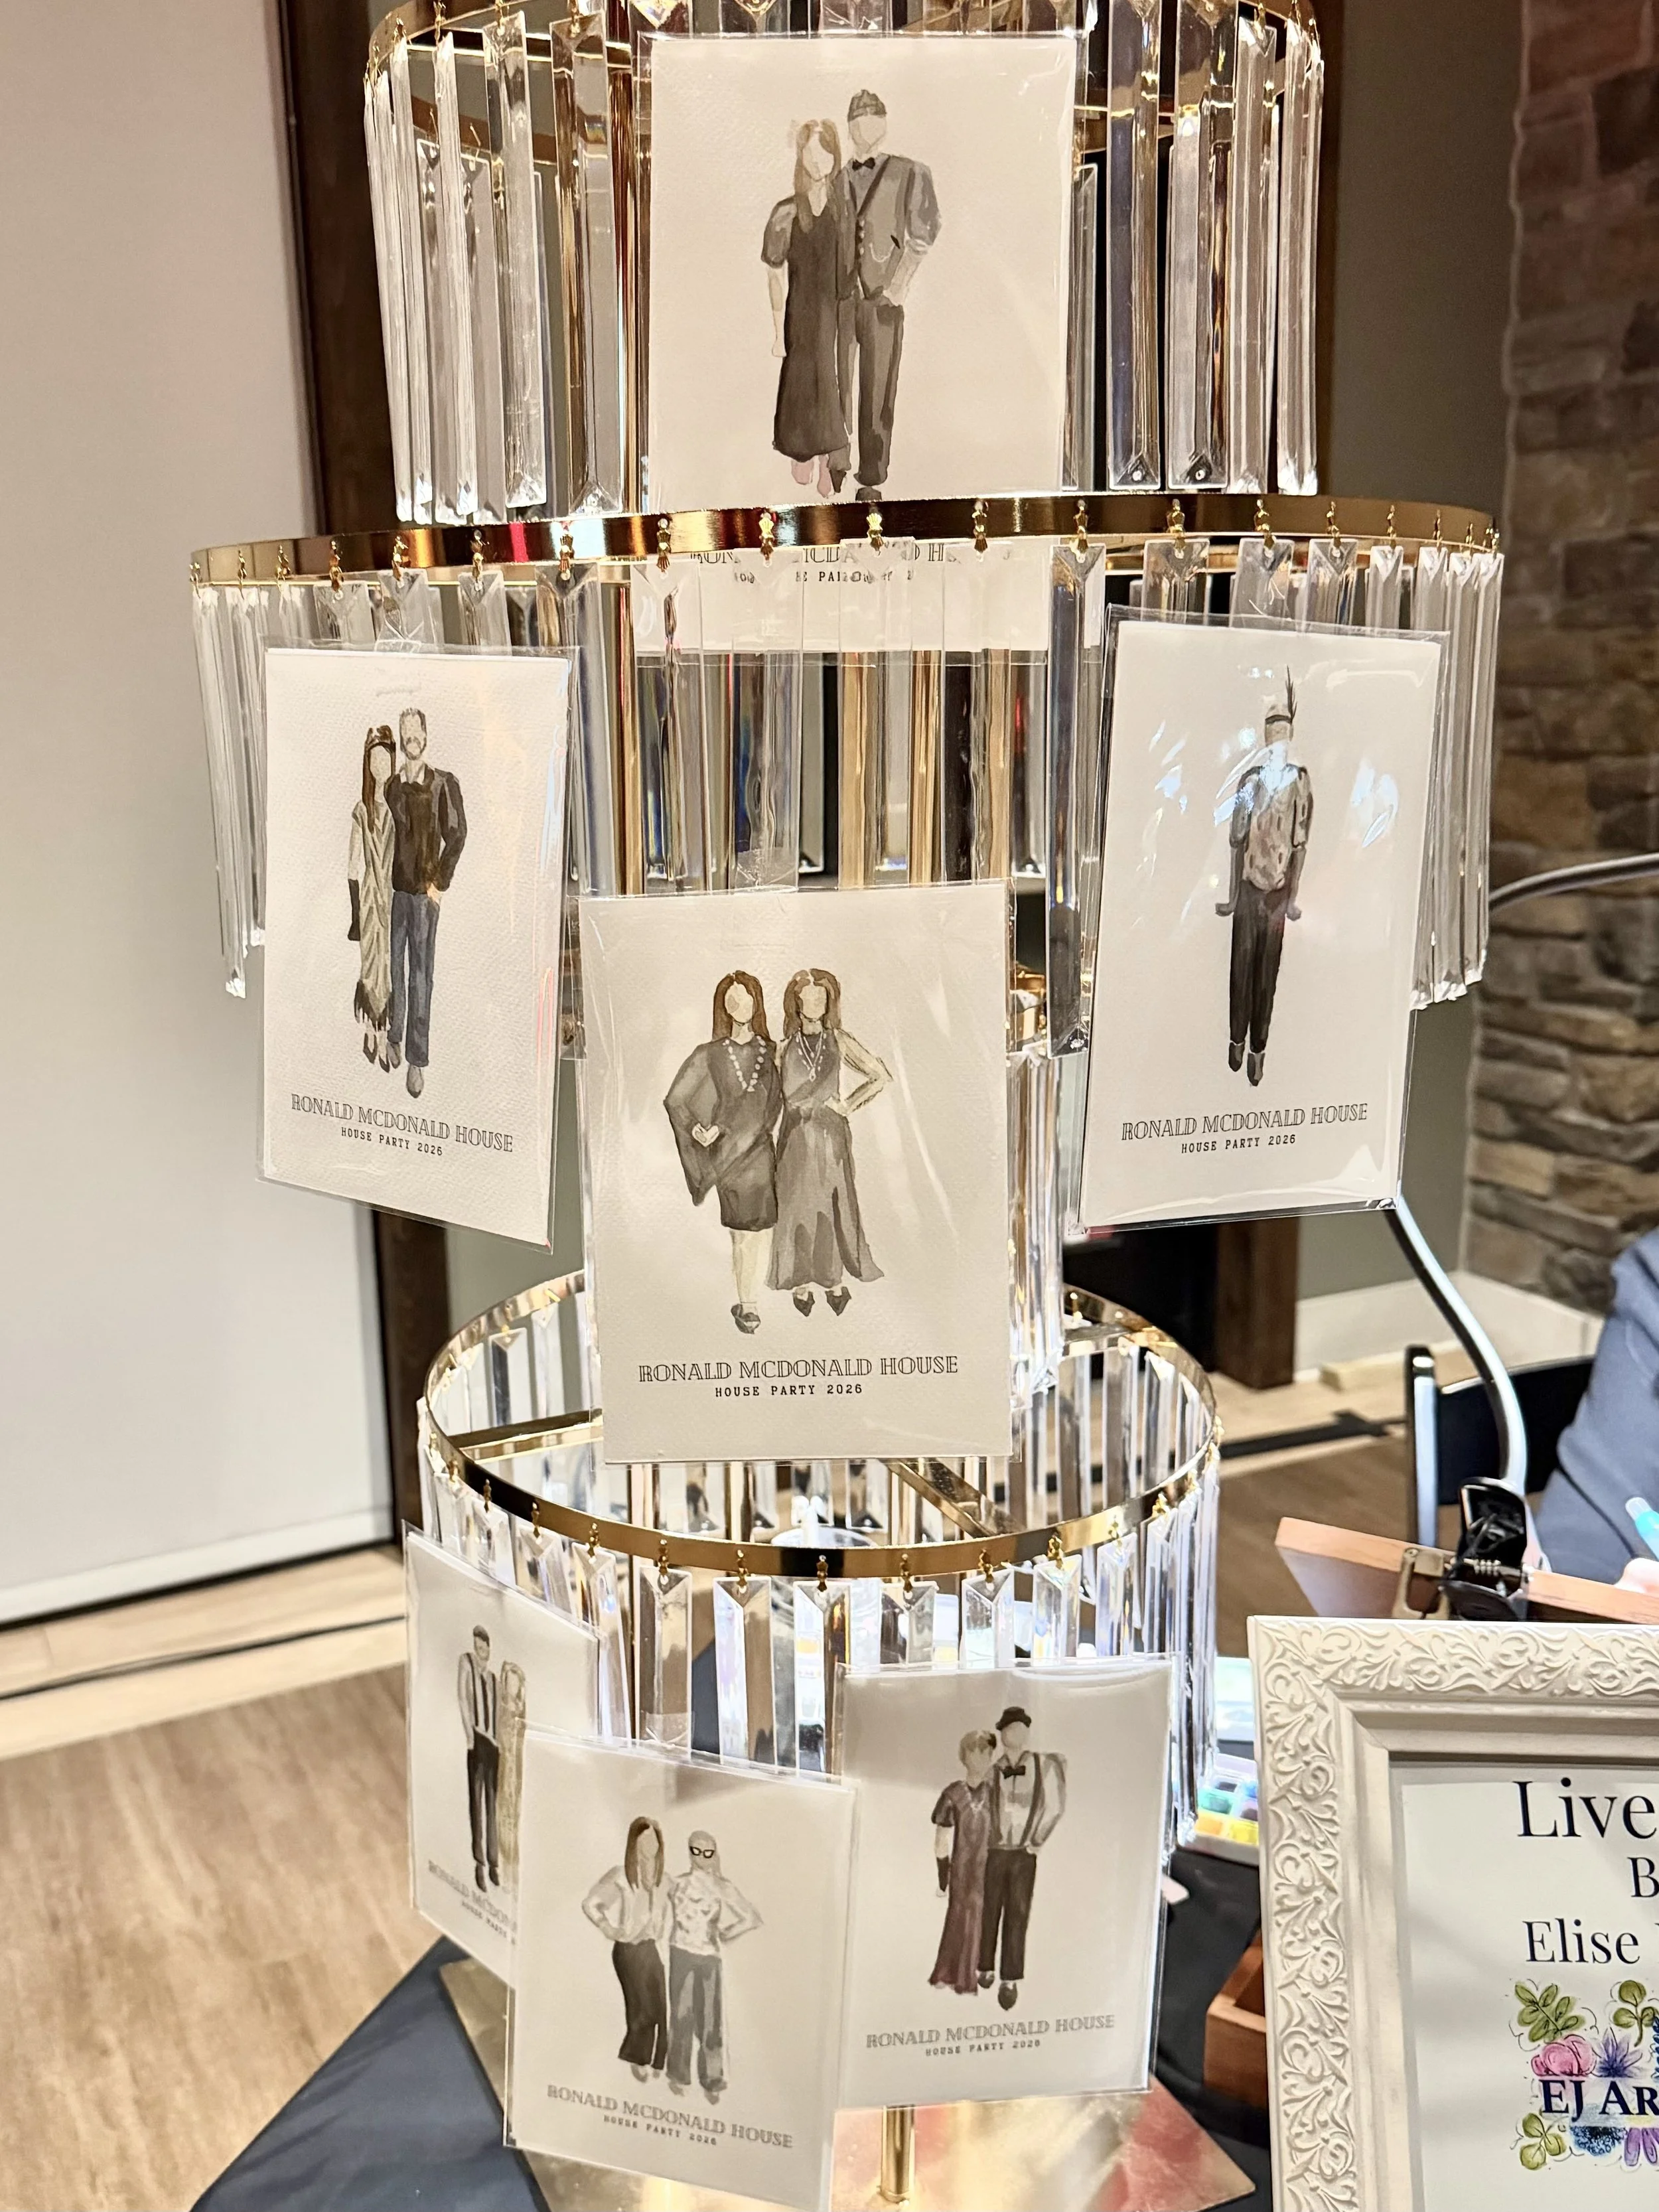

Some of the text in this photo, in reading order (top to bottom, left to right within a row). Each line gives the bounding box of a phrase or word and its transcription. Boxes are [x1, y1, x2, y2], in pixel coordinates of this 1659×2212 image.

[291, 1094, 513, 1152] RONALD MCDONALD HOUSE
[1121, 1103, 1368, 1140] RONALD MCDONALD HOUSE
[341, 1127, 443, 1156] HOUSE PARTY 2026
[1181, 1134, 1296, 1153] HOUSE PARTY 2026
[639, 1356, 958, 1382] RONALD MCDONALD HOUSE
[715, 1383, 863, 1397] HOUSE PARTY 2026
[1512, 1777, 1658, 1840] Live
[1626, 1857, 1659, 1897] B
[1522, 1919, 1640, 1964] Elise
[866, 2015, 1115, 2048] RONALD MCDONALD HOUSE
[547, 2085, 793, 2148] RONALD MCDONALD HOUSE
[1539, 2080, 1585, 2122] EJ
